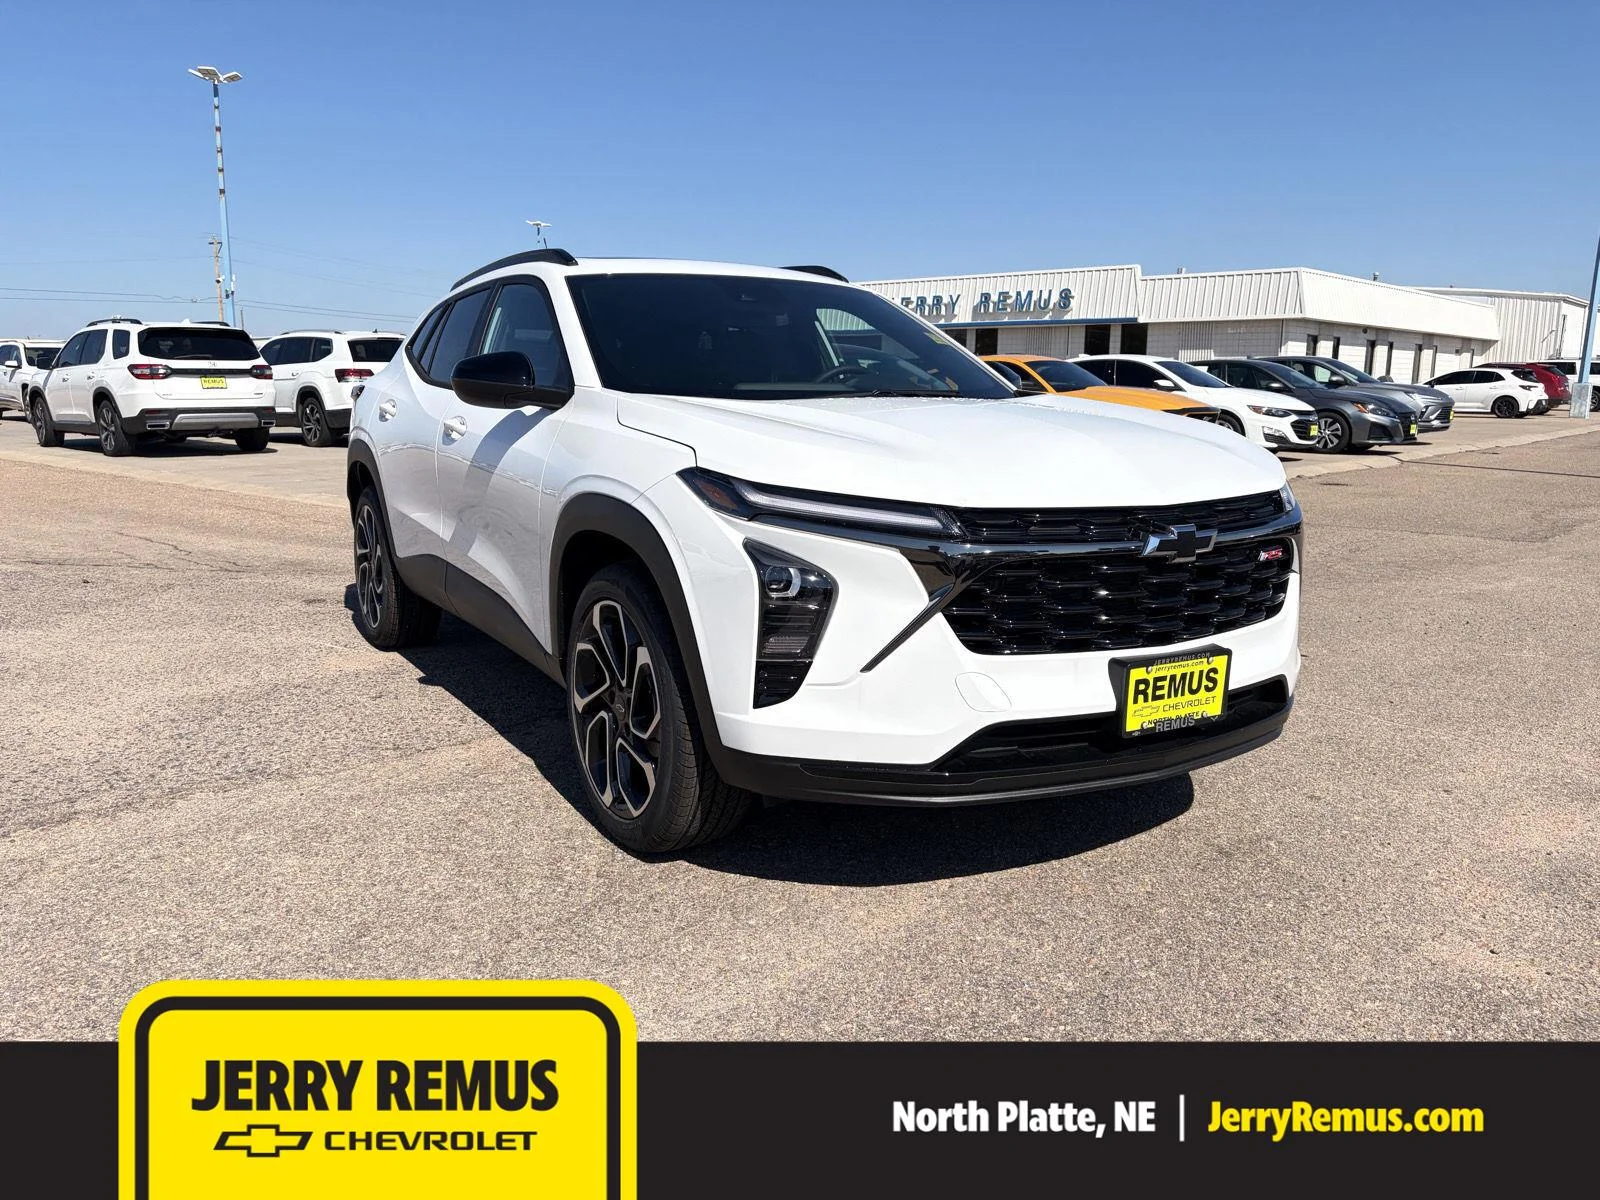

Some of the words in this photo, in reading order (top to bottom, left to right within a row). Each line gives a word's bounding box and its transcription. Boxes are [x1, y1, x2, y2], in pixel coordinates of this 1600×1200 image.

[892, 294, 961, 315] ERRY
[978, 288, 1074, 312] REMUS
[1153, 652, 1210, 666] JERRYREMUS.COM
[1154, 660, 1205, 673] jerryremus.com
[1132, 667, 1219, 705] REMUS
[1162, 696, 1217, 712] CHEVROLET
[1155, 717, 1195, 733] REMUS
